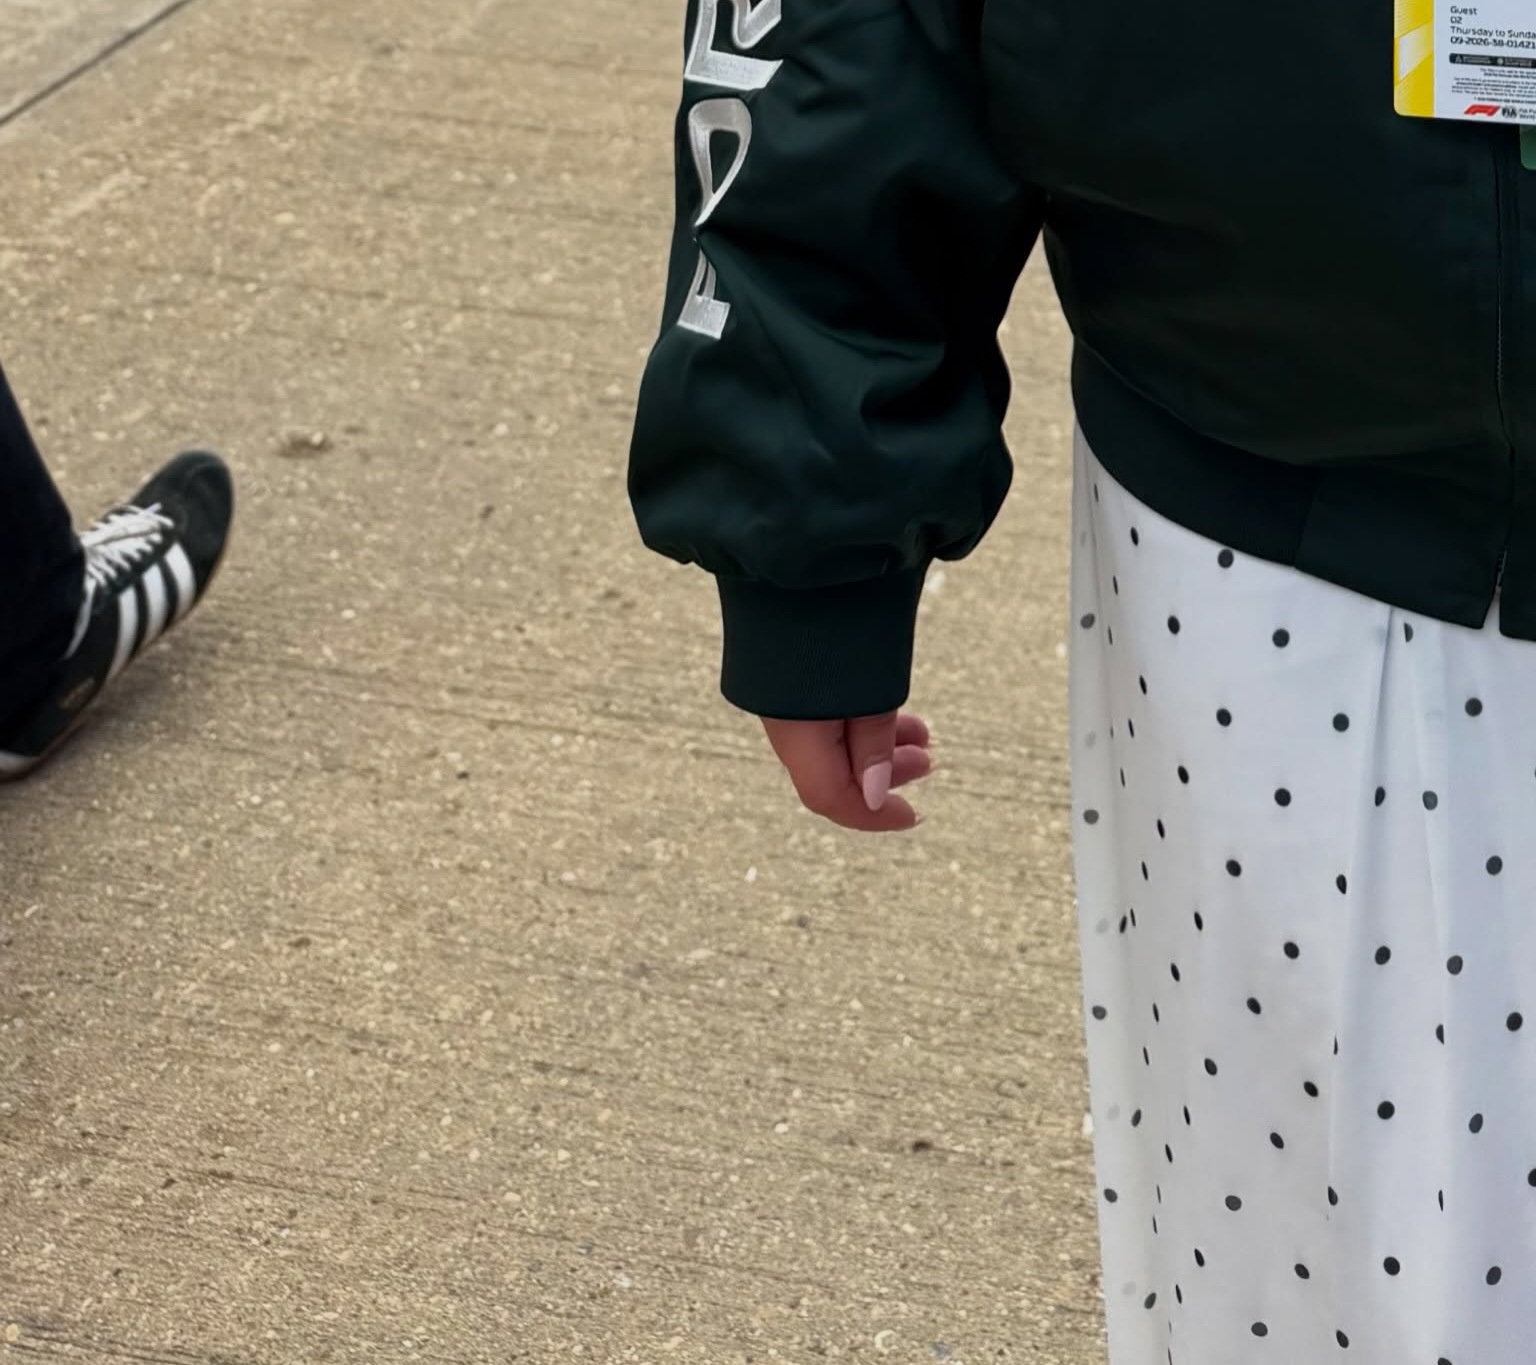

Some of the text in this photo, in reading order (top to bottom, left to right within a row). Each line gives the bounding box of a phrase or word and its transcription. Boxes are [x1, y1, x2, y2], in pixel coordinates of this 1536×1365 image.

[1450, 5, 1478, 15] Guest
[1450, 25, 1493, 38] Thursday
[1495, 29, 1506, 37] to
